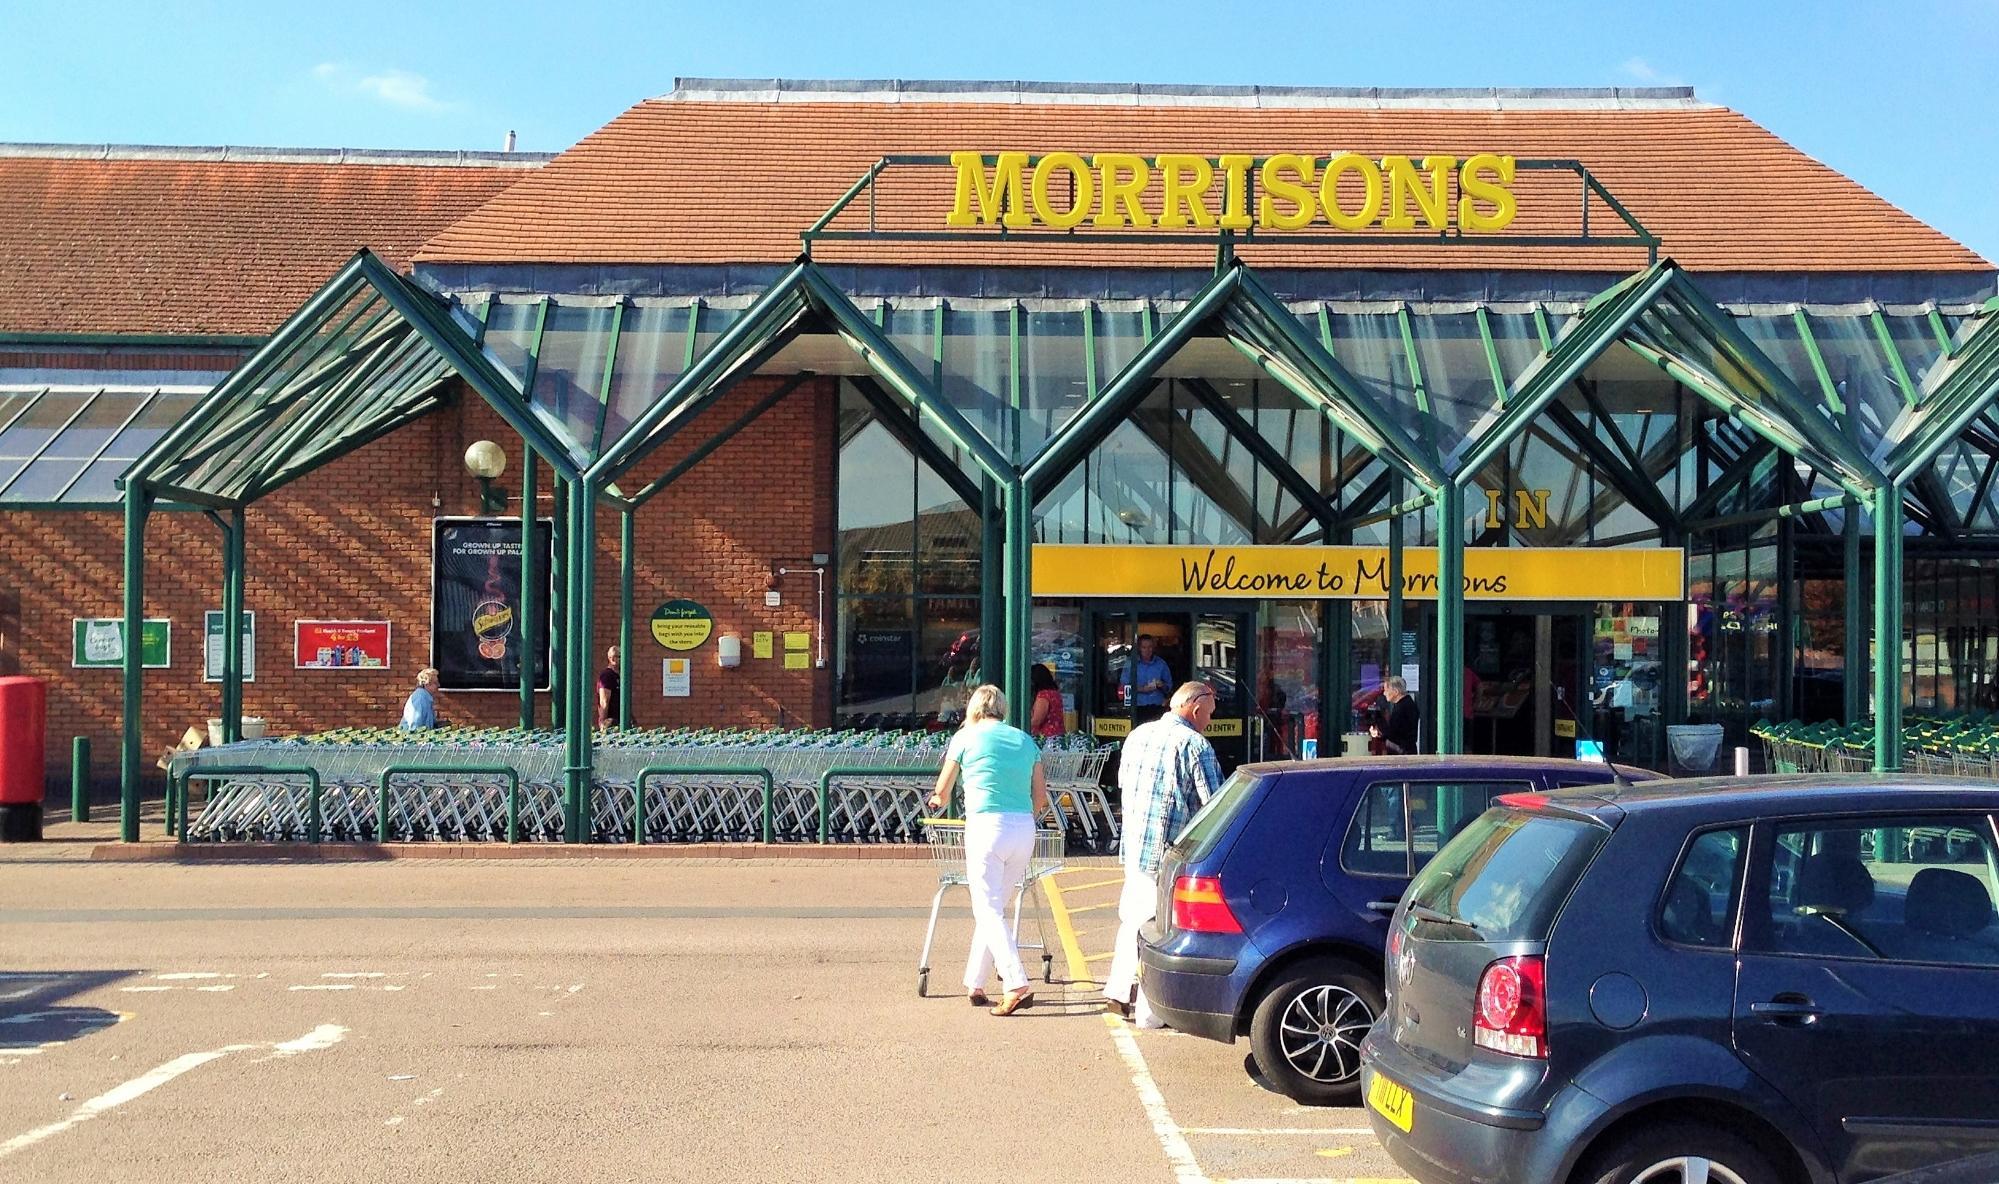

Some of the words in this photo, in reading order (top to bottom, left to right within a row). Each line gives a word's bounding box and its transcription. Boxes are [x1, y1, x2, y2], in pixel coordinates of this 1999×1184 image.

[946, 150, 1517, 231] MORRISONS
[1485, 489, 1551, 529] IN
[1181, 549, 1313, 592] Welcome
[1317, 562, 1345, 592] to
[1353, 557, 1508, 594] Mrrons
[870, 634, 902, 642] coinstar
[1099, 723, 1108, 732] NO
[1108, 724, 1127, 732] ENTRY
[1213, 723, 1236, 732] ENTRY
